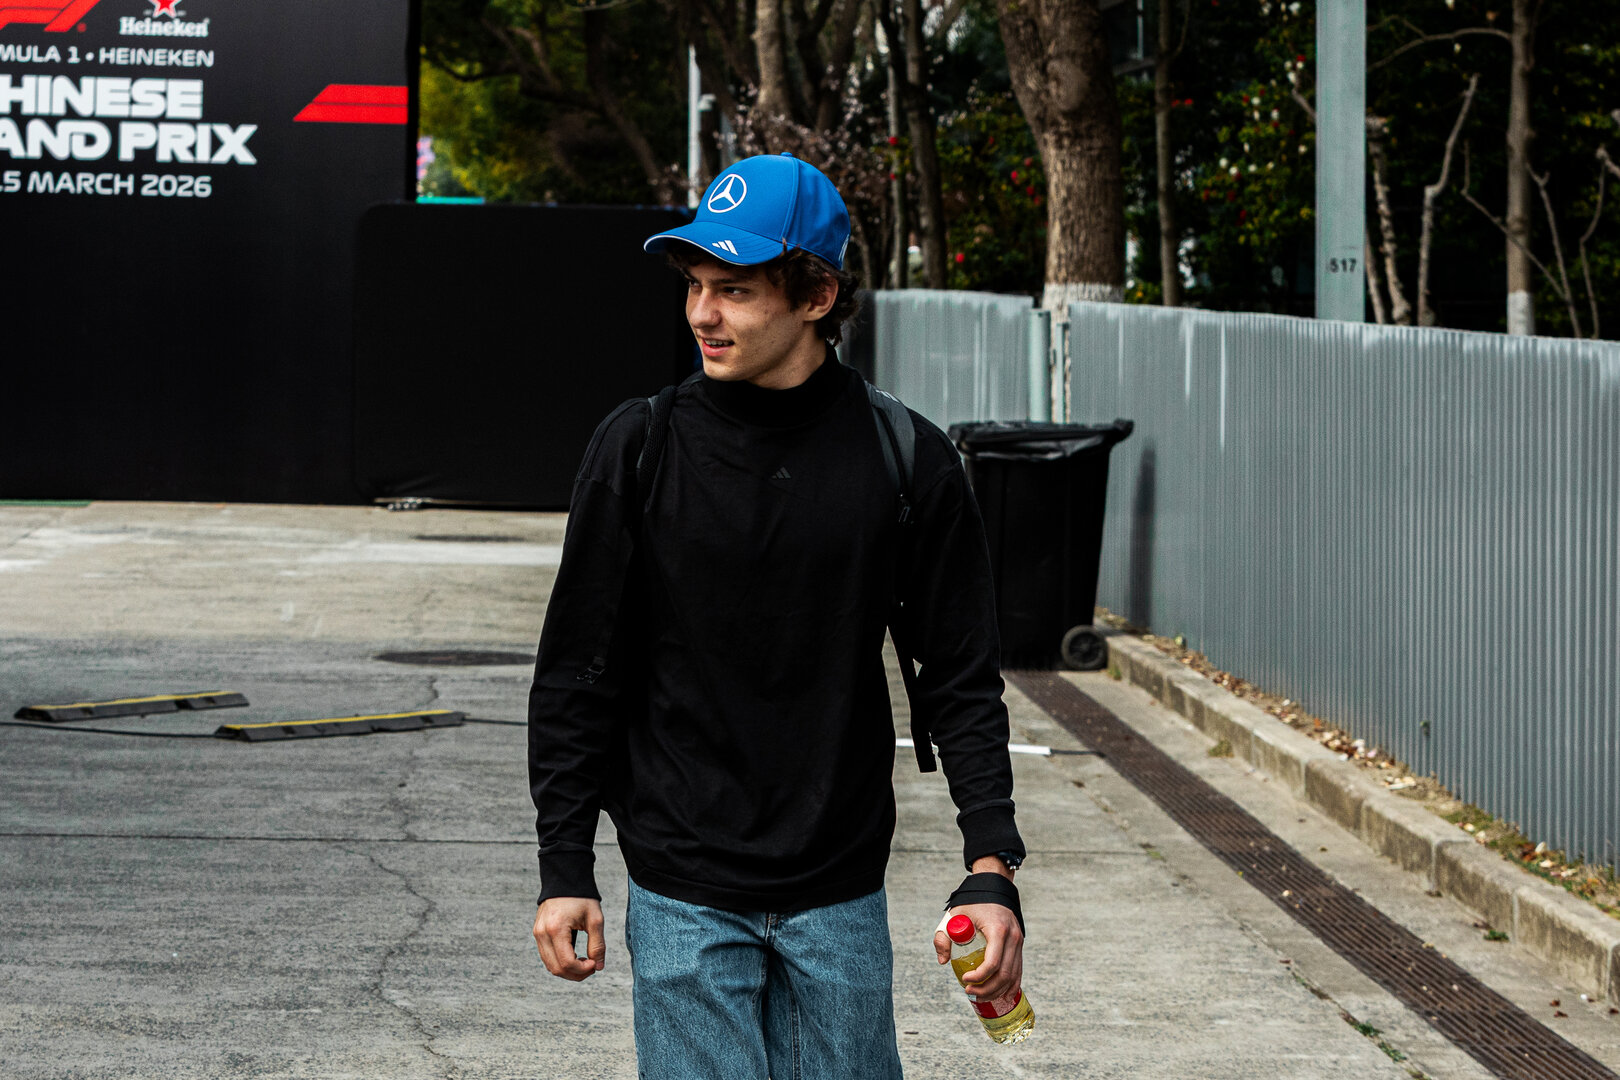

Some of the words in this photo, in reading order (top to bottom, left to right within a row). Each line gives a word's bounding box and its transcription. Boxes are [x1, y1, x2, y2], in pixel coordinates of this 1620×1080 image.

[119, 16, 209, 37] Heineken
[67, 46, 80, 63] 1
[99, 47, 214, 67] HEINEKEN
[0, 74, 203, 119] HINESE
[119, 121, 258, 164] PRIX
[0, 170, 21, 193] 5
[27, 171, 134, 195] MARCH
[141, 175, 212, 197] 2026
